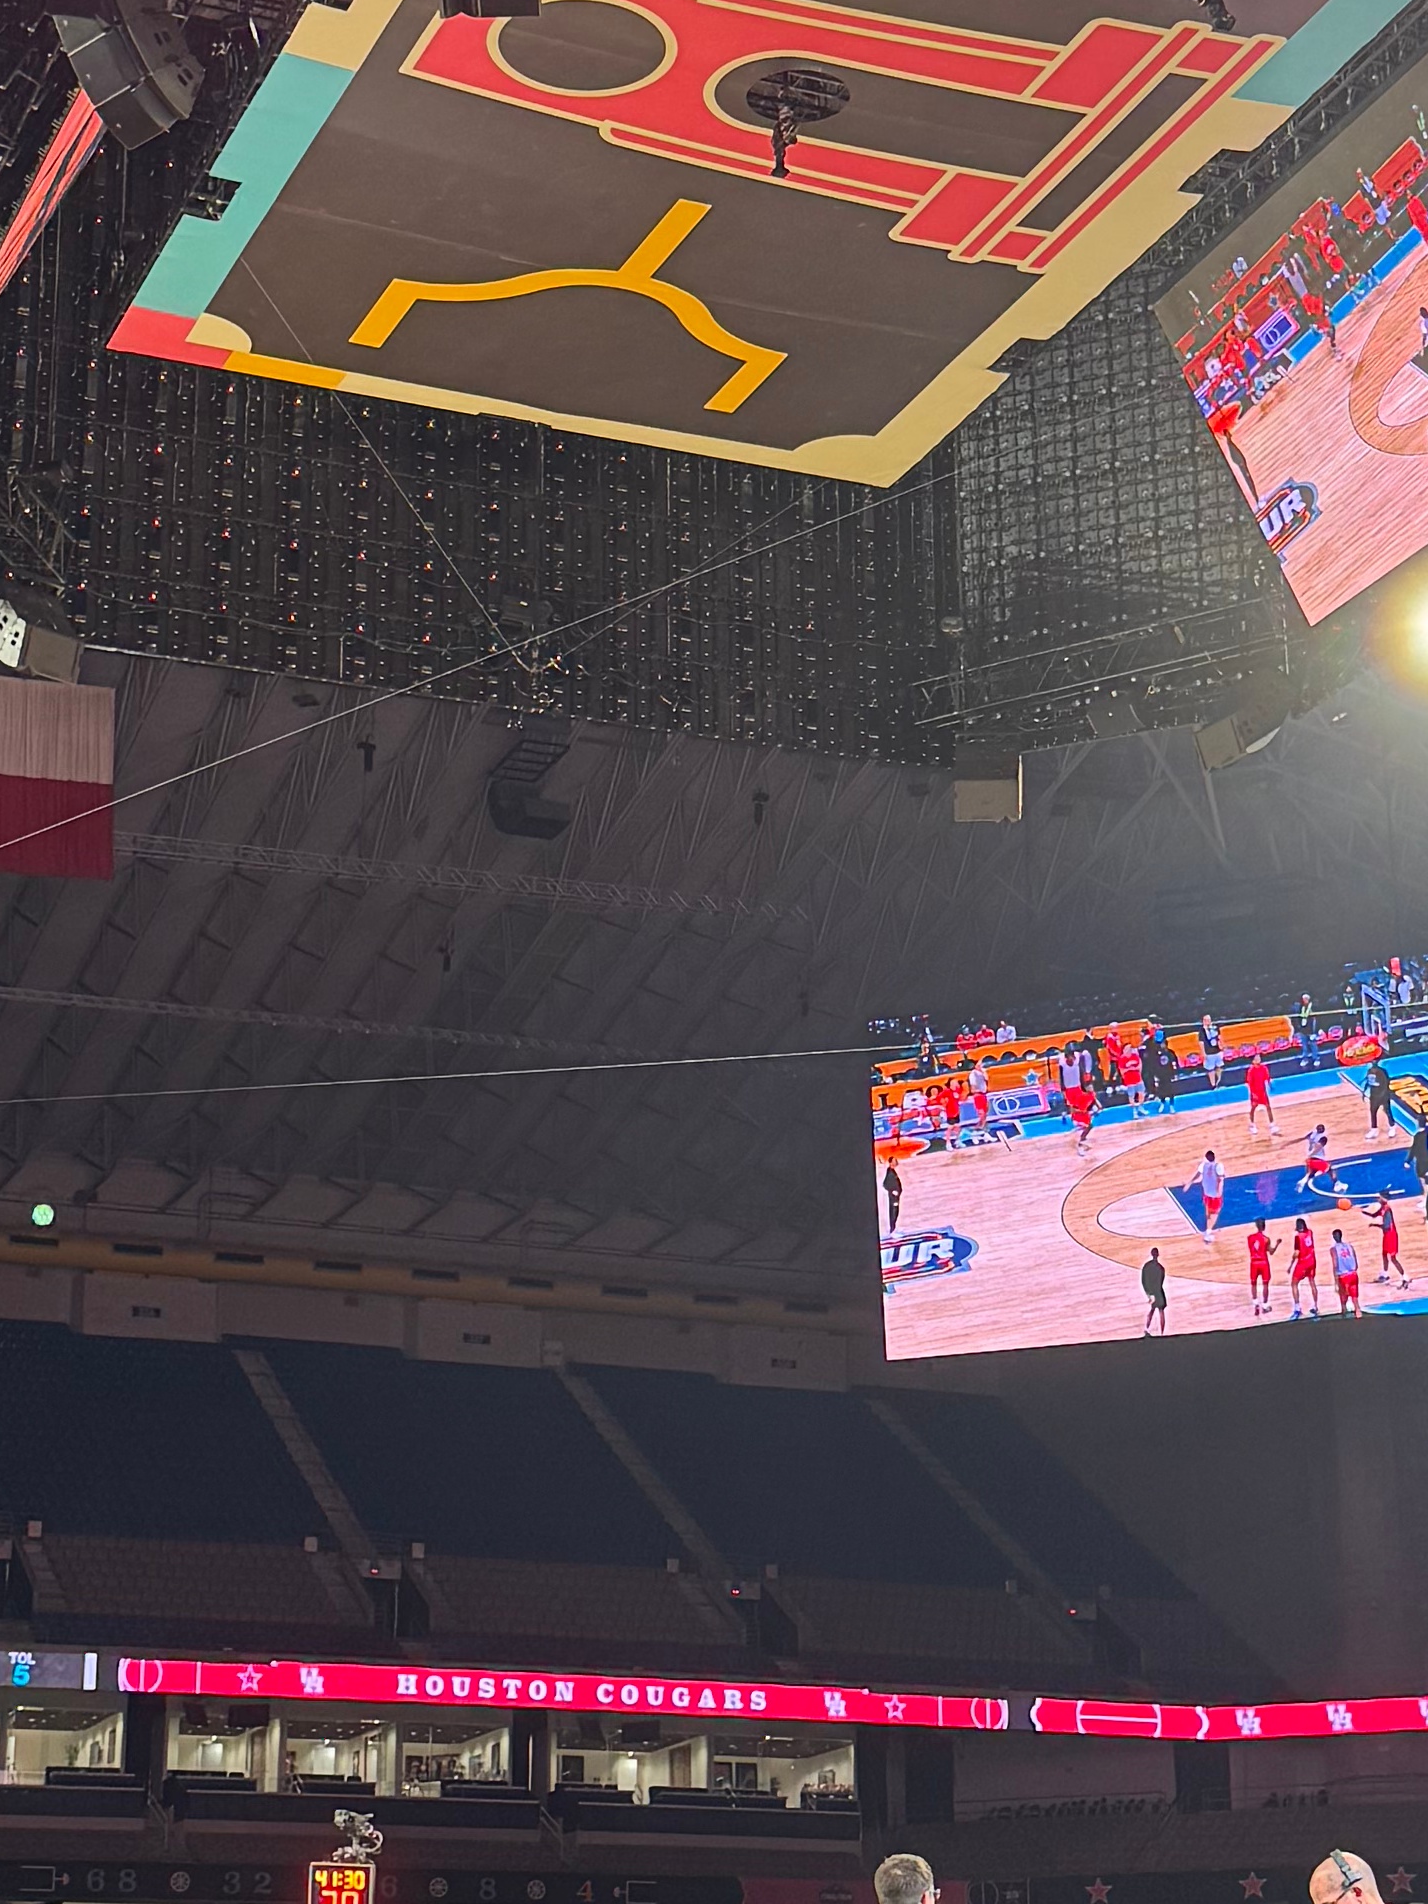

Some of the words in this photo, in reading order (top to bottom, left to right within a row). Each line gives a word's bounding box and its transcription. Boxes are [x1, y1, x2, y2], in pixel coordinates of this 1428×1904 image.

[8, 1652, 36, 1665] TOL
[12, 1664, 31, 1687] 5
[396, 1673, 575, 1702] HOUSTON
[596, 1683, 769, 1712] COUGARS
[86, 1869, 138, 1893] 68
[315, 1870, 366, 1890] 41:30
[577, 1879, 593, 1903] 4
